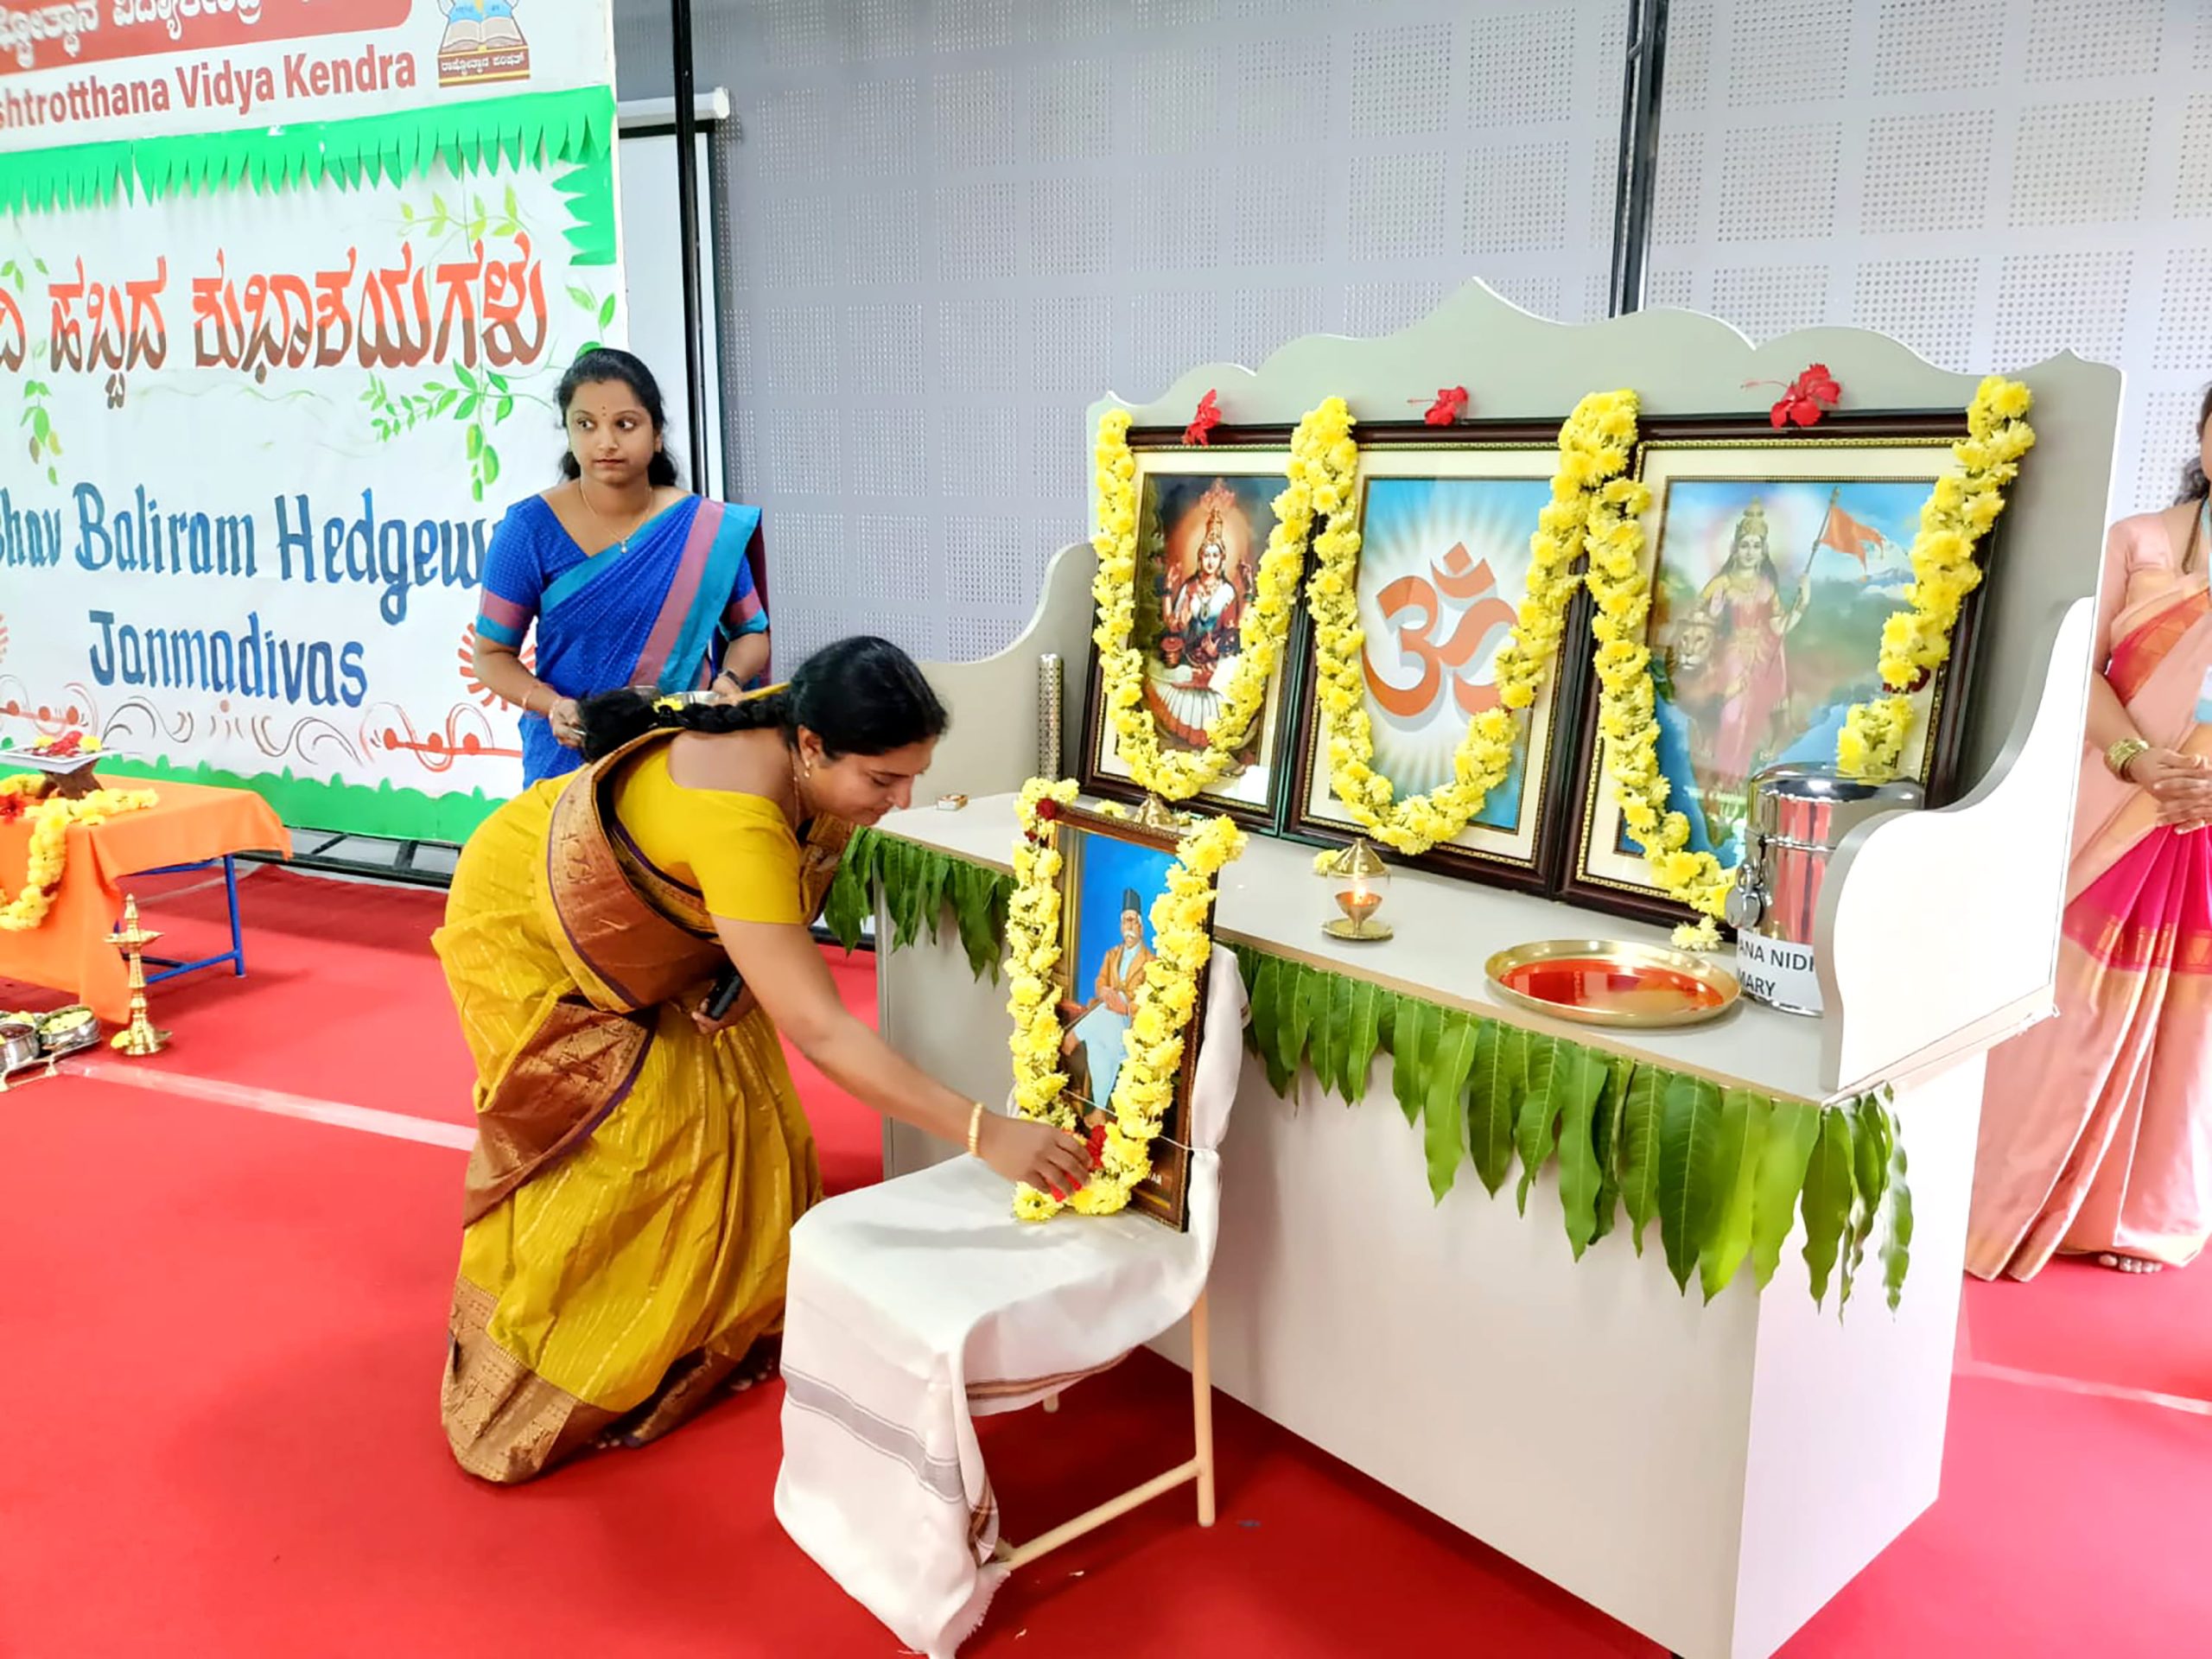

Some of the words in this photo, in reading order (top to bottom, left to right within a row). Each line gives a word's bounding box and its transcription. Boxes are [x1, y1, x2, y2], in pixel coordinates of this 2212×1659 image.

[175, 60, 275, 115] Vidya
[283, 44, 416, 99] Kendra
[192, 231, 547, 385] ಶುಭಾಶಯಗಳು
[0, 486, 61, 568] hav
[73, 482, 258, 578] Baliram
[274, 487, 505, 626] Hedgew
[89, 609, 367, 708] Janmadivas
